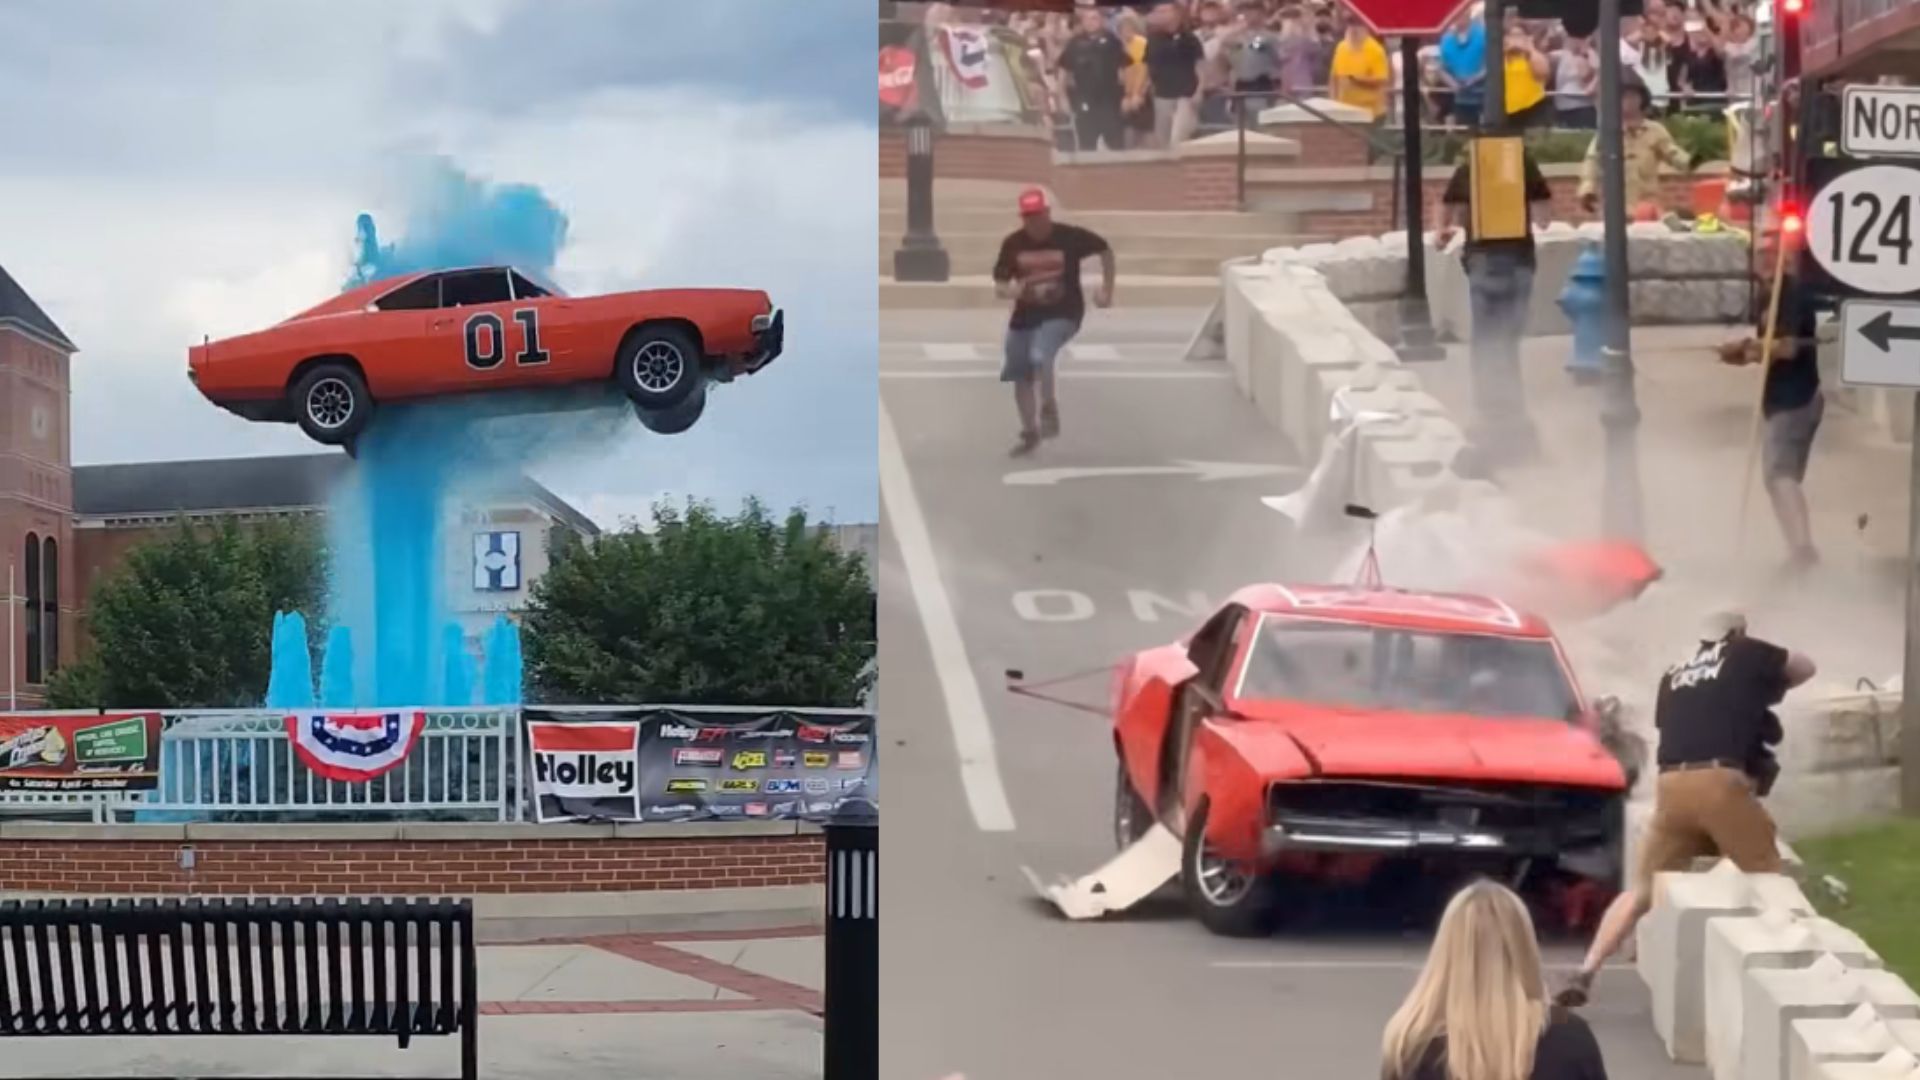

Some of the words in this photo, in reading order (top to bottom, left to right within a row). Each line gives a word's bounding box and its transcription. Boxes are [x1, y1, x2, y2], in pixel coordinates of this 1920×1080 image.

[1829, 192, 1920, 265] 124
[463, 307, 551, 370] 01
[535, 752, 634, 793] Holley
